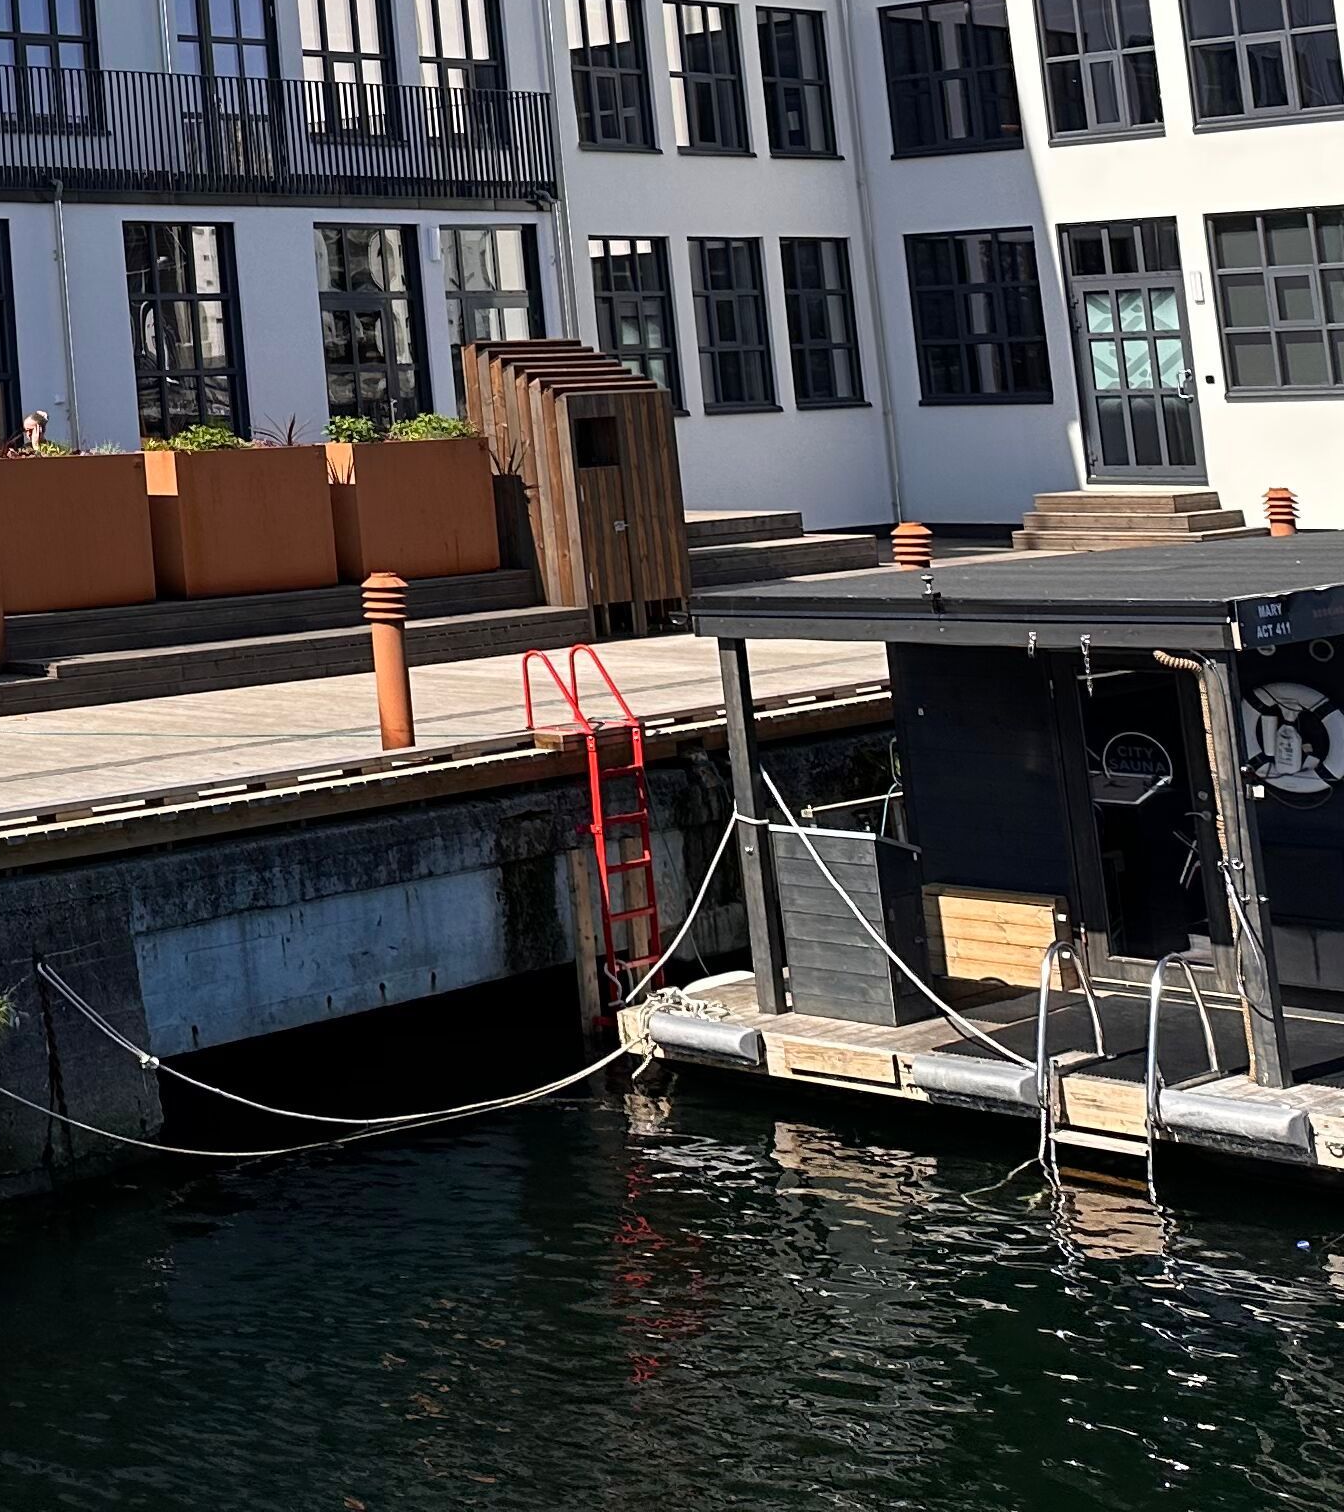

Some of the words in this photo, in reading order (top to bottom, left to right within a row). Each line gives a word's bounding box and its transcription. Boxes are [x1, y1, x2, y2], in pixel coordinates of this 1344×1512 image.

[1257, 603, 1282, 618] MARY
[1257, 624, 1273, 639] ACT
[1275, 621, 1292, 636] 411
[1117, 745, 1154, 759] CITY
[1109, 758, 1167, 774] SAUNA
